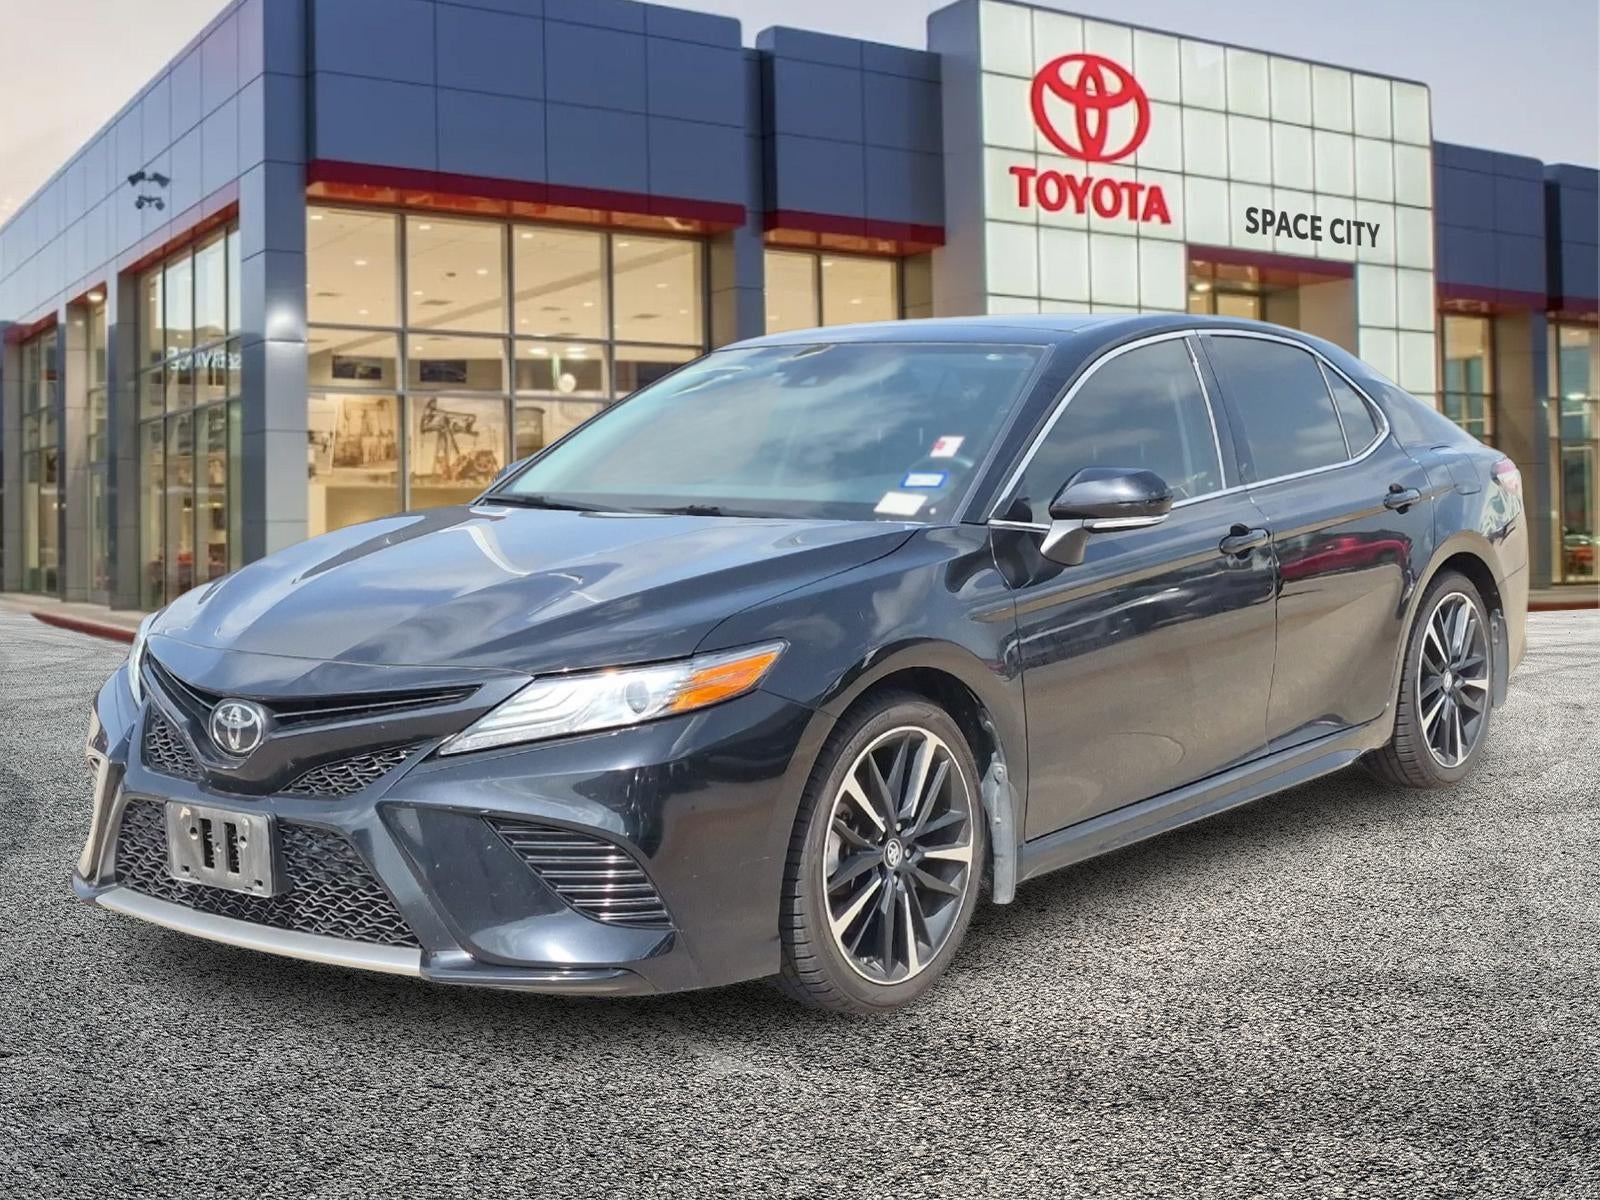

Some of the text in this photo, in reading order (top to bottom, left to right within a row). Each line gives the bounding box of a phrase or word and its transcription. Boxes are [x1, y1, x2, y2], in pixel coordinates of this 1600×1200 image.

[1009, 166, 1171, 224] TOYOTA
[1245, 206, 1380, 248] SPACE CITY
